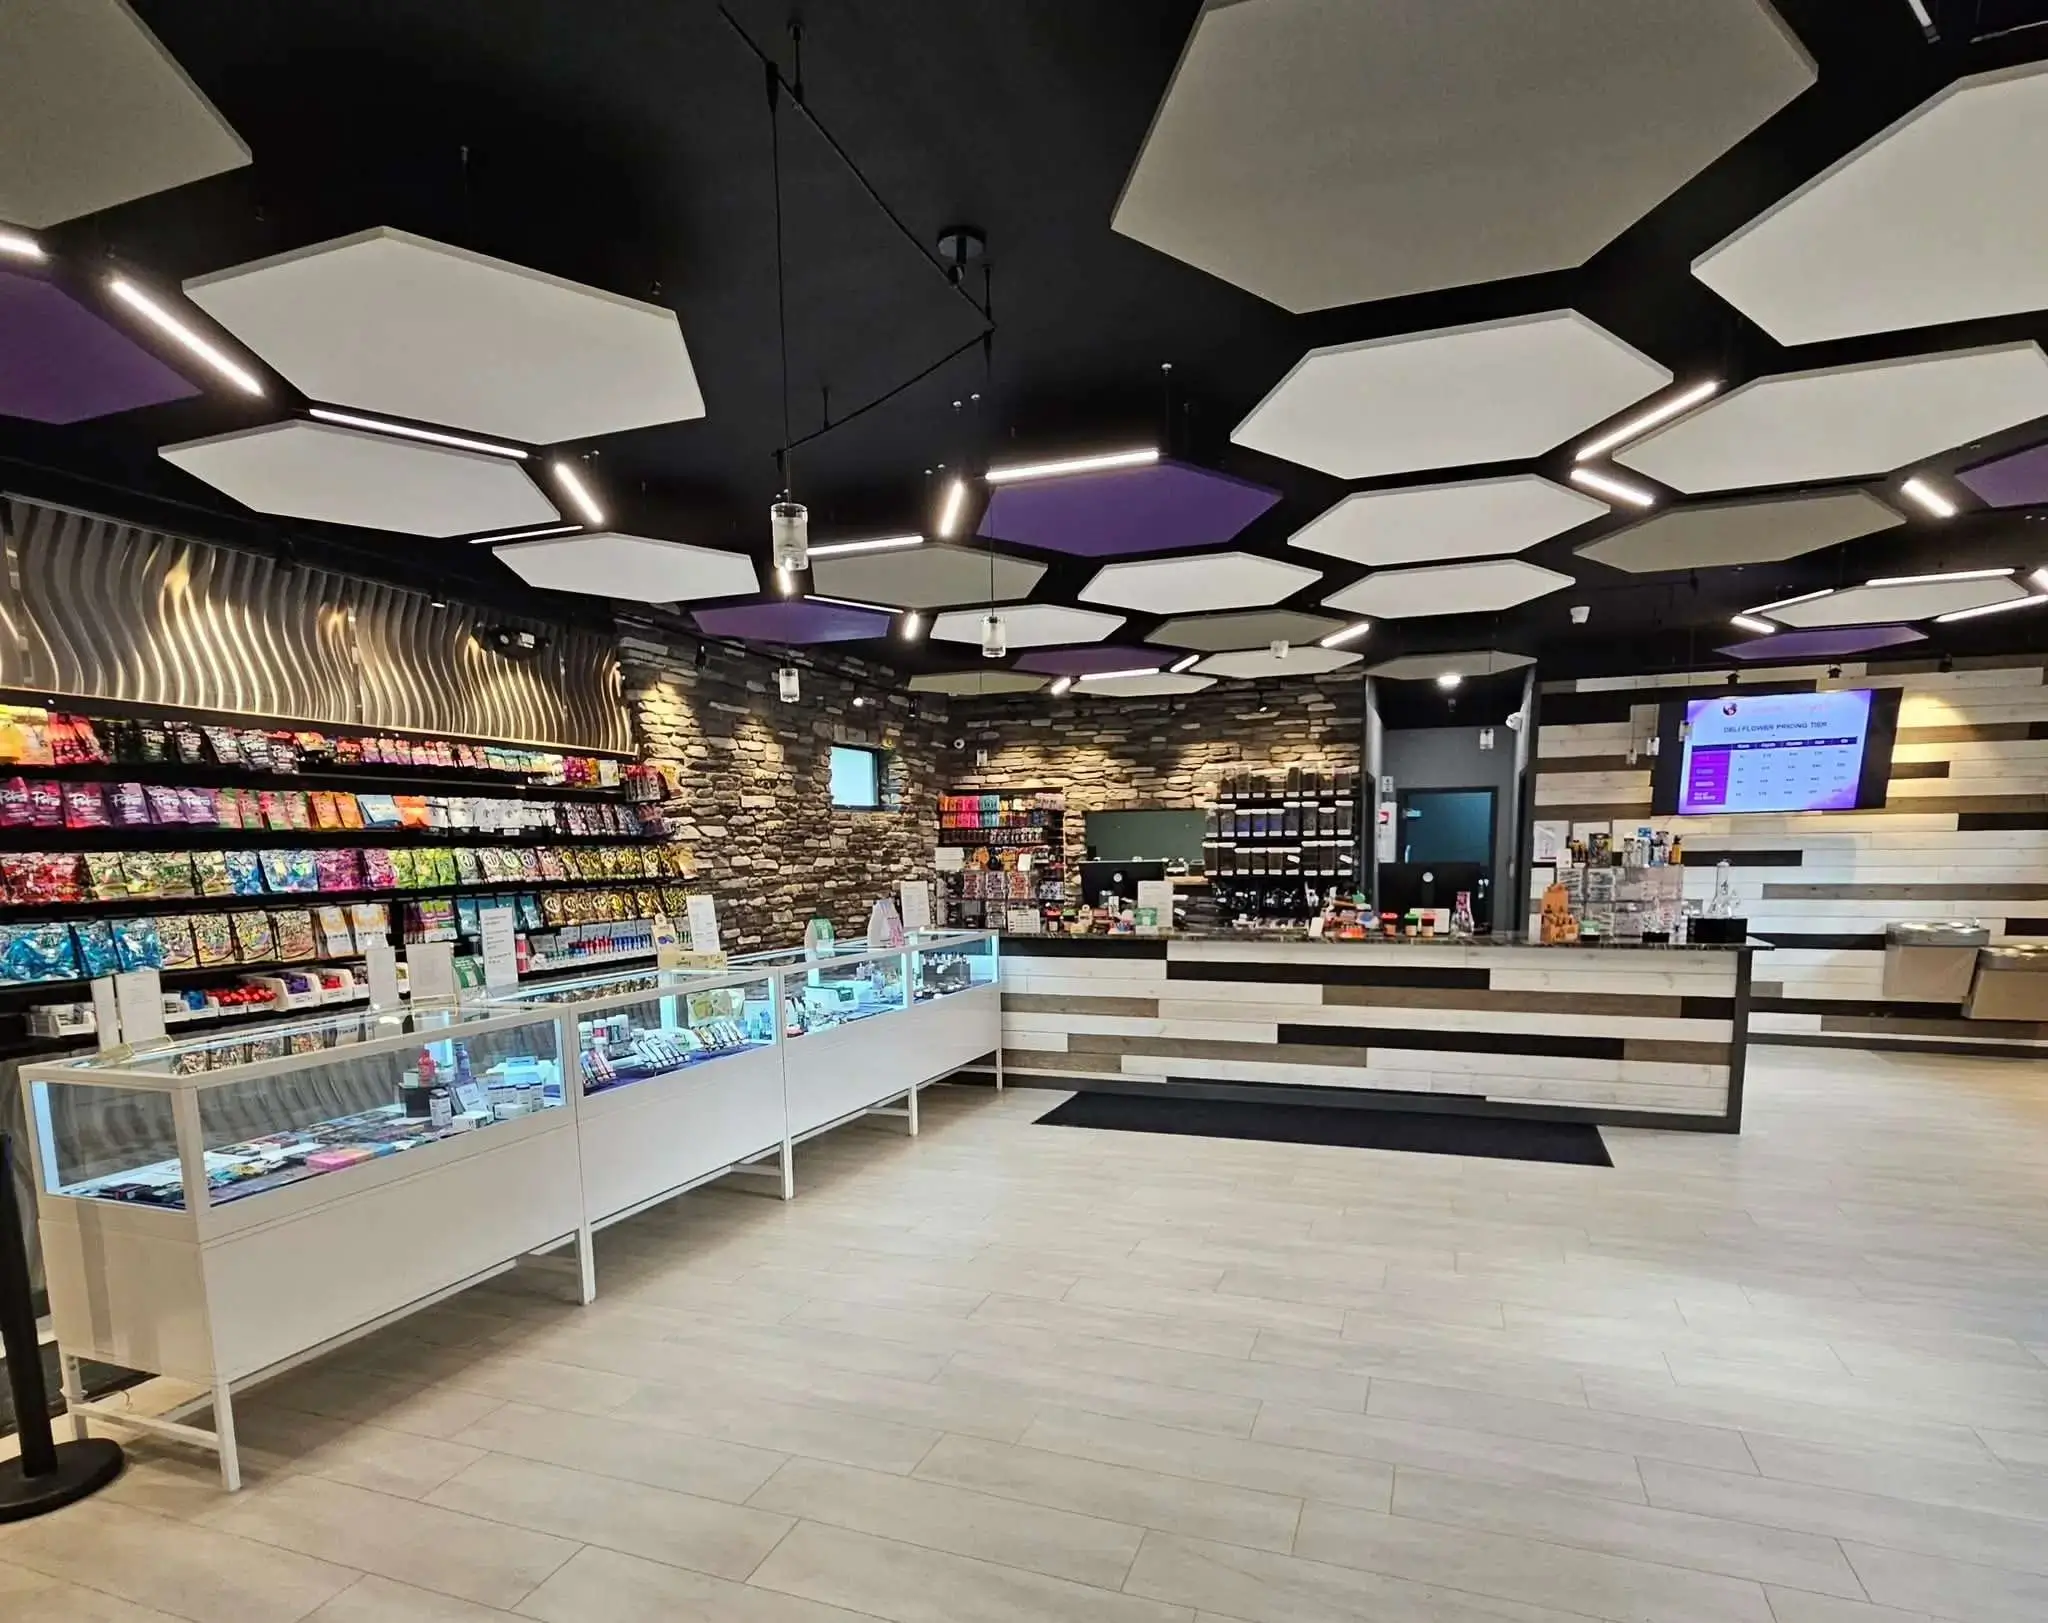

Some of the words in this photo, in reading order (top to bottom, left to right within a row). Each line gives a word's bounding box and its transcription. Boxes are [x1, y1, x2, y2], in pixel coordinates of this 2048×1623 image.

[1741, 724, 1774, 732] FLOWER
[1776, 722, 1808, 730] PRICING
[1810, 721, 1828, 729] TIER
